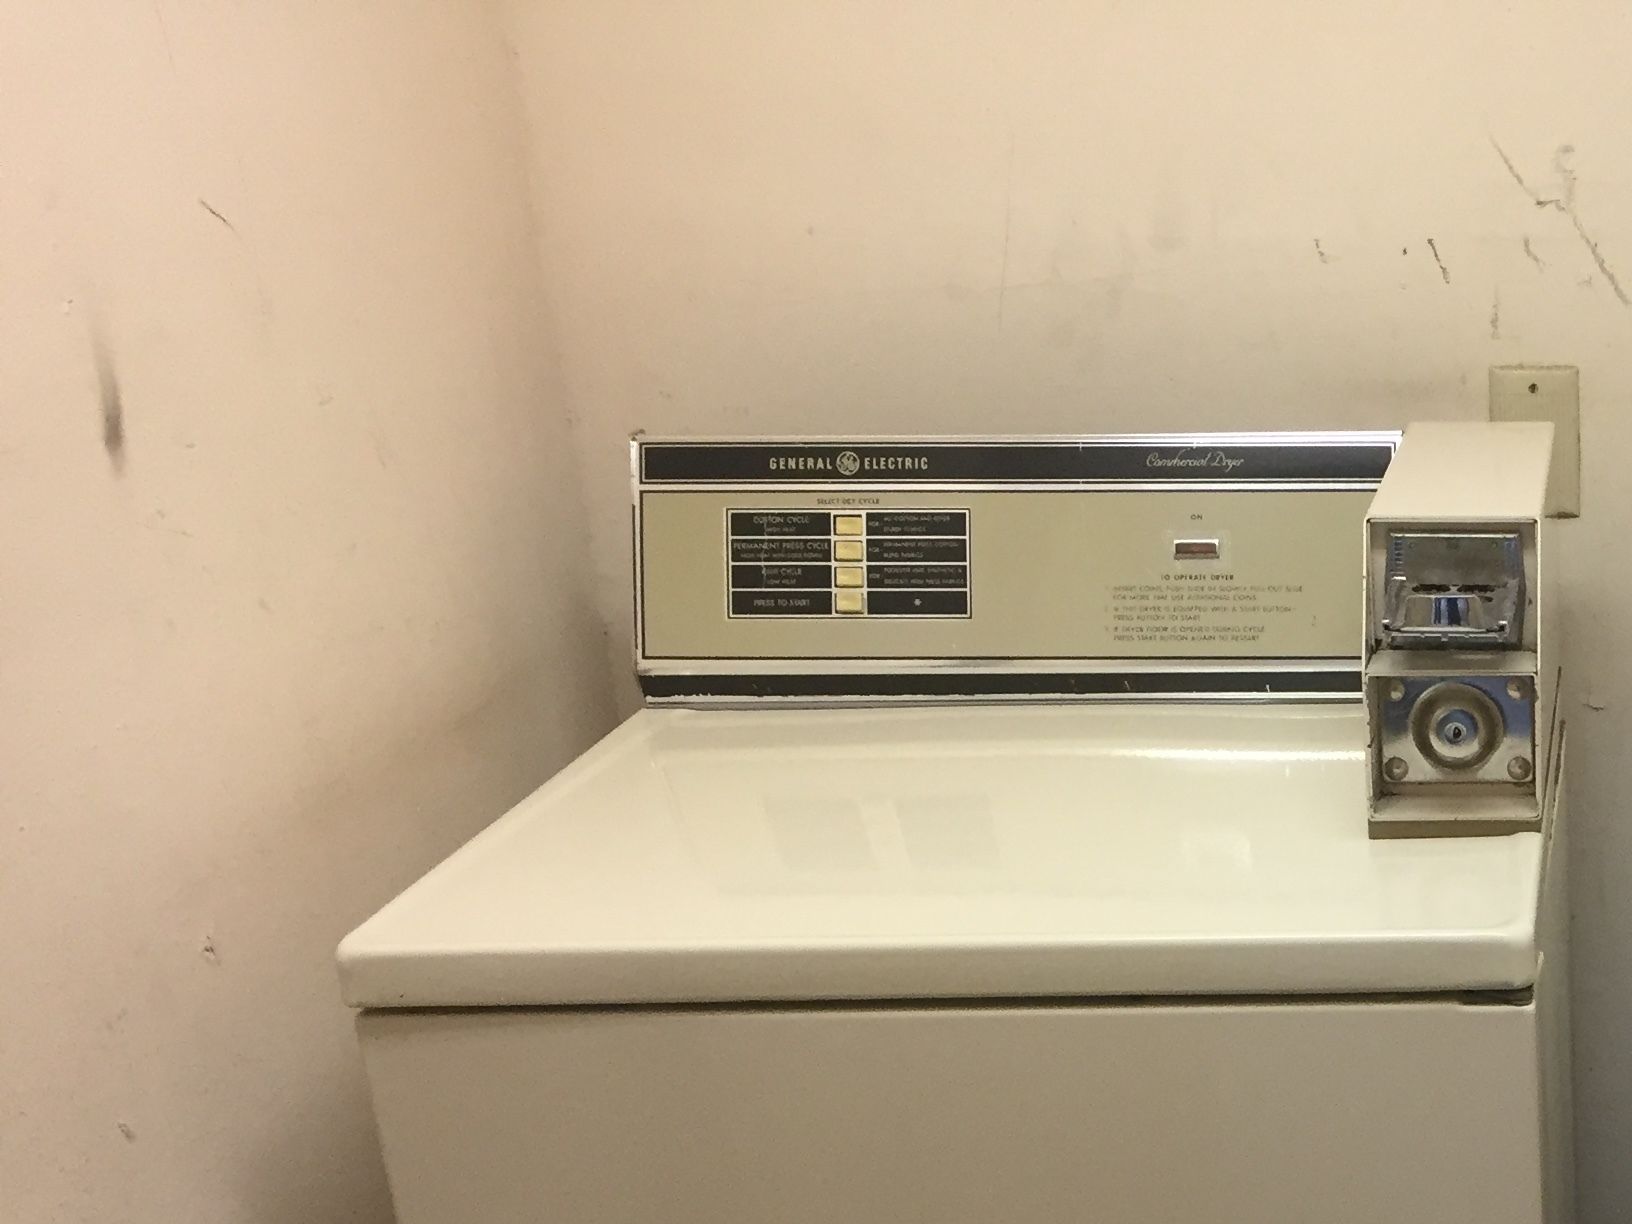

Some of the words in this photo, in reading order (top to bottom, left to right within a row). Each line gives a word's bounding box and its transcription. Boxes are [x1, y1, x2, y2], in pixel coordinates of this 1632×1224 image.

[769, 457, 833, 470] GENERAL
[864, 457, 928, 470] ELECTRIC
[1211, 449, 1244, 472] Dryer
